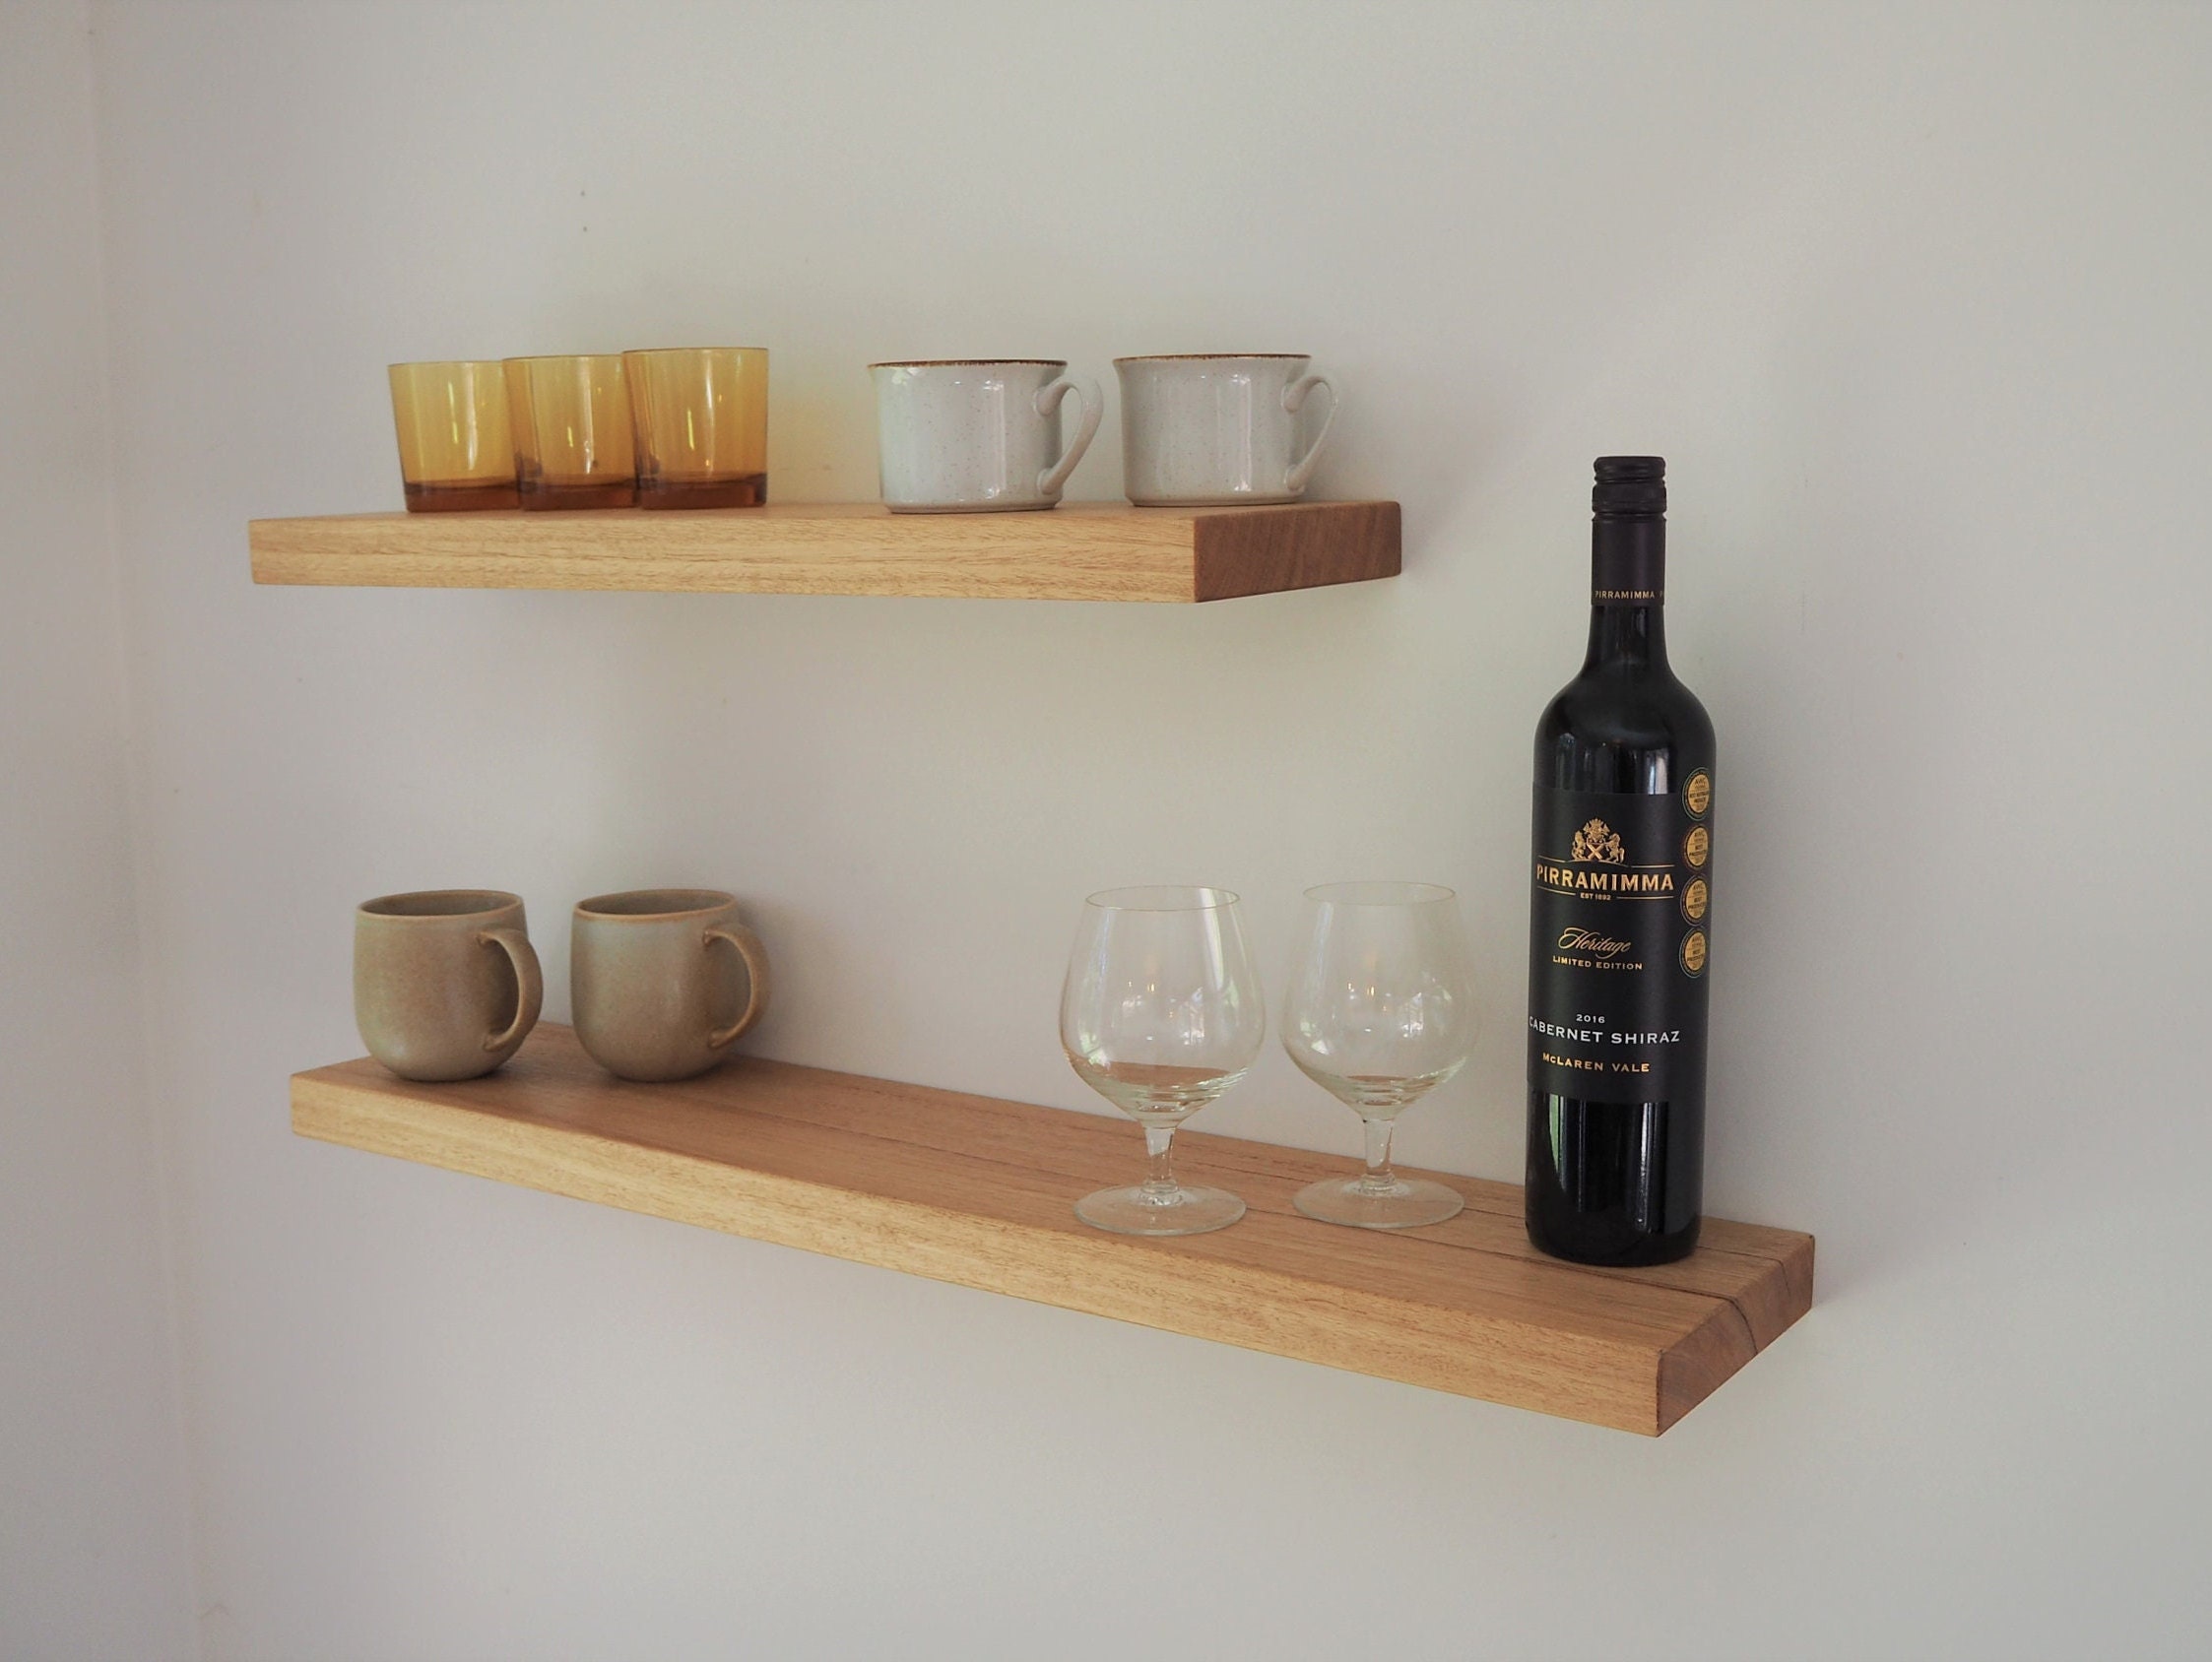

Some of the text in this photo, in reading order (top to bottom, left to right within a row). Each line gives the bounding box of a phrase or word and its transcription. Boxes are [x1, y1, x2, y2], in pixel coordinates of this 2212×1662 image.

[1594, 590, 1655, 600] PIRRAMIMMA
[1536, 863, 1674, 892] PIRRAMIMMA
[1558, 927, 1632, 960] Heritage
[1552, 955, 1643, 970] LIMITED EDITION
[1576, 1013, 1605, 1024] 2016
[1529, 1015, 1680, 1045] CABERNET SHIRAZ
[1542, 1052, 1650, 1072] McLAREN VALE
